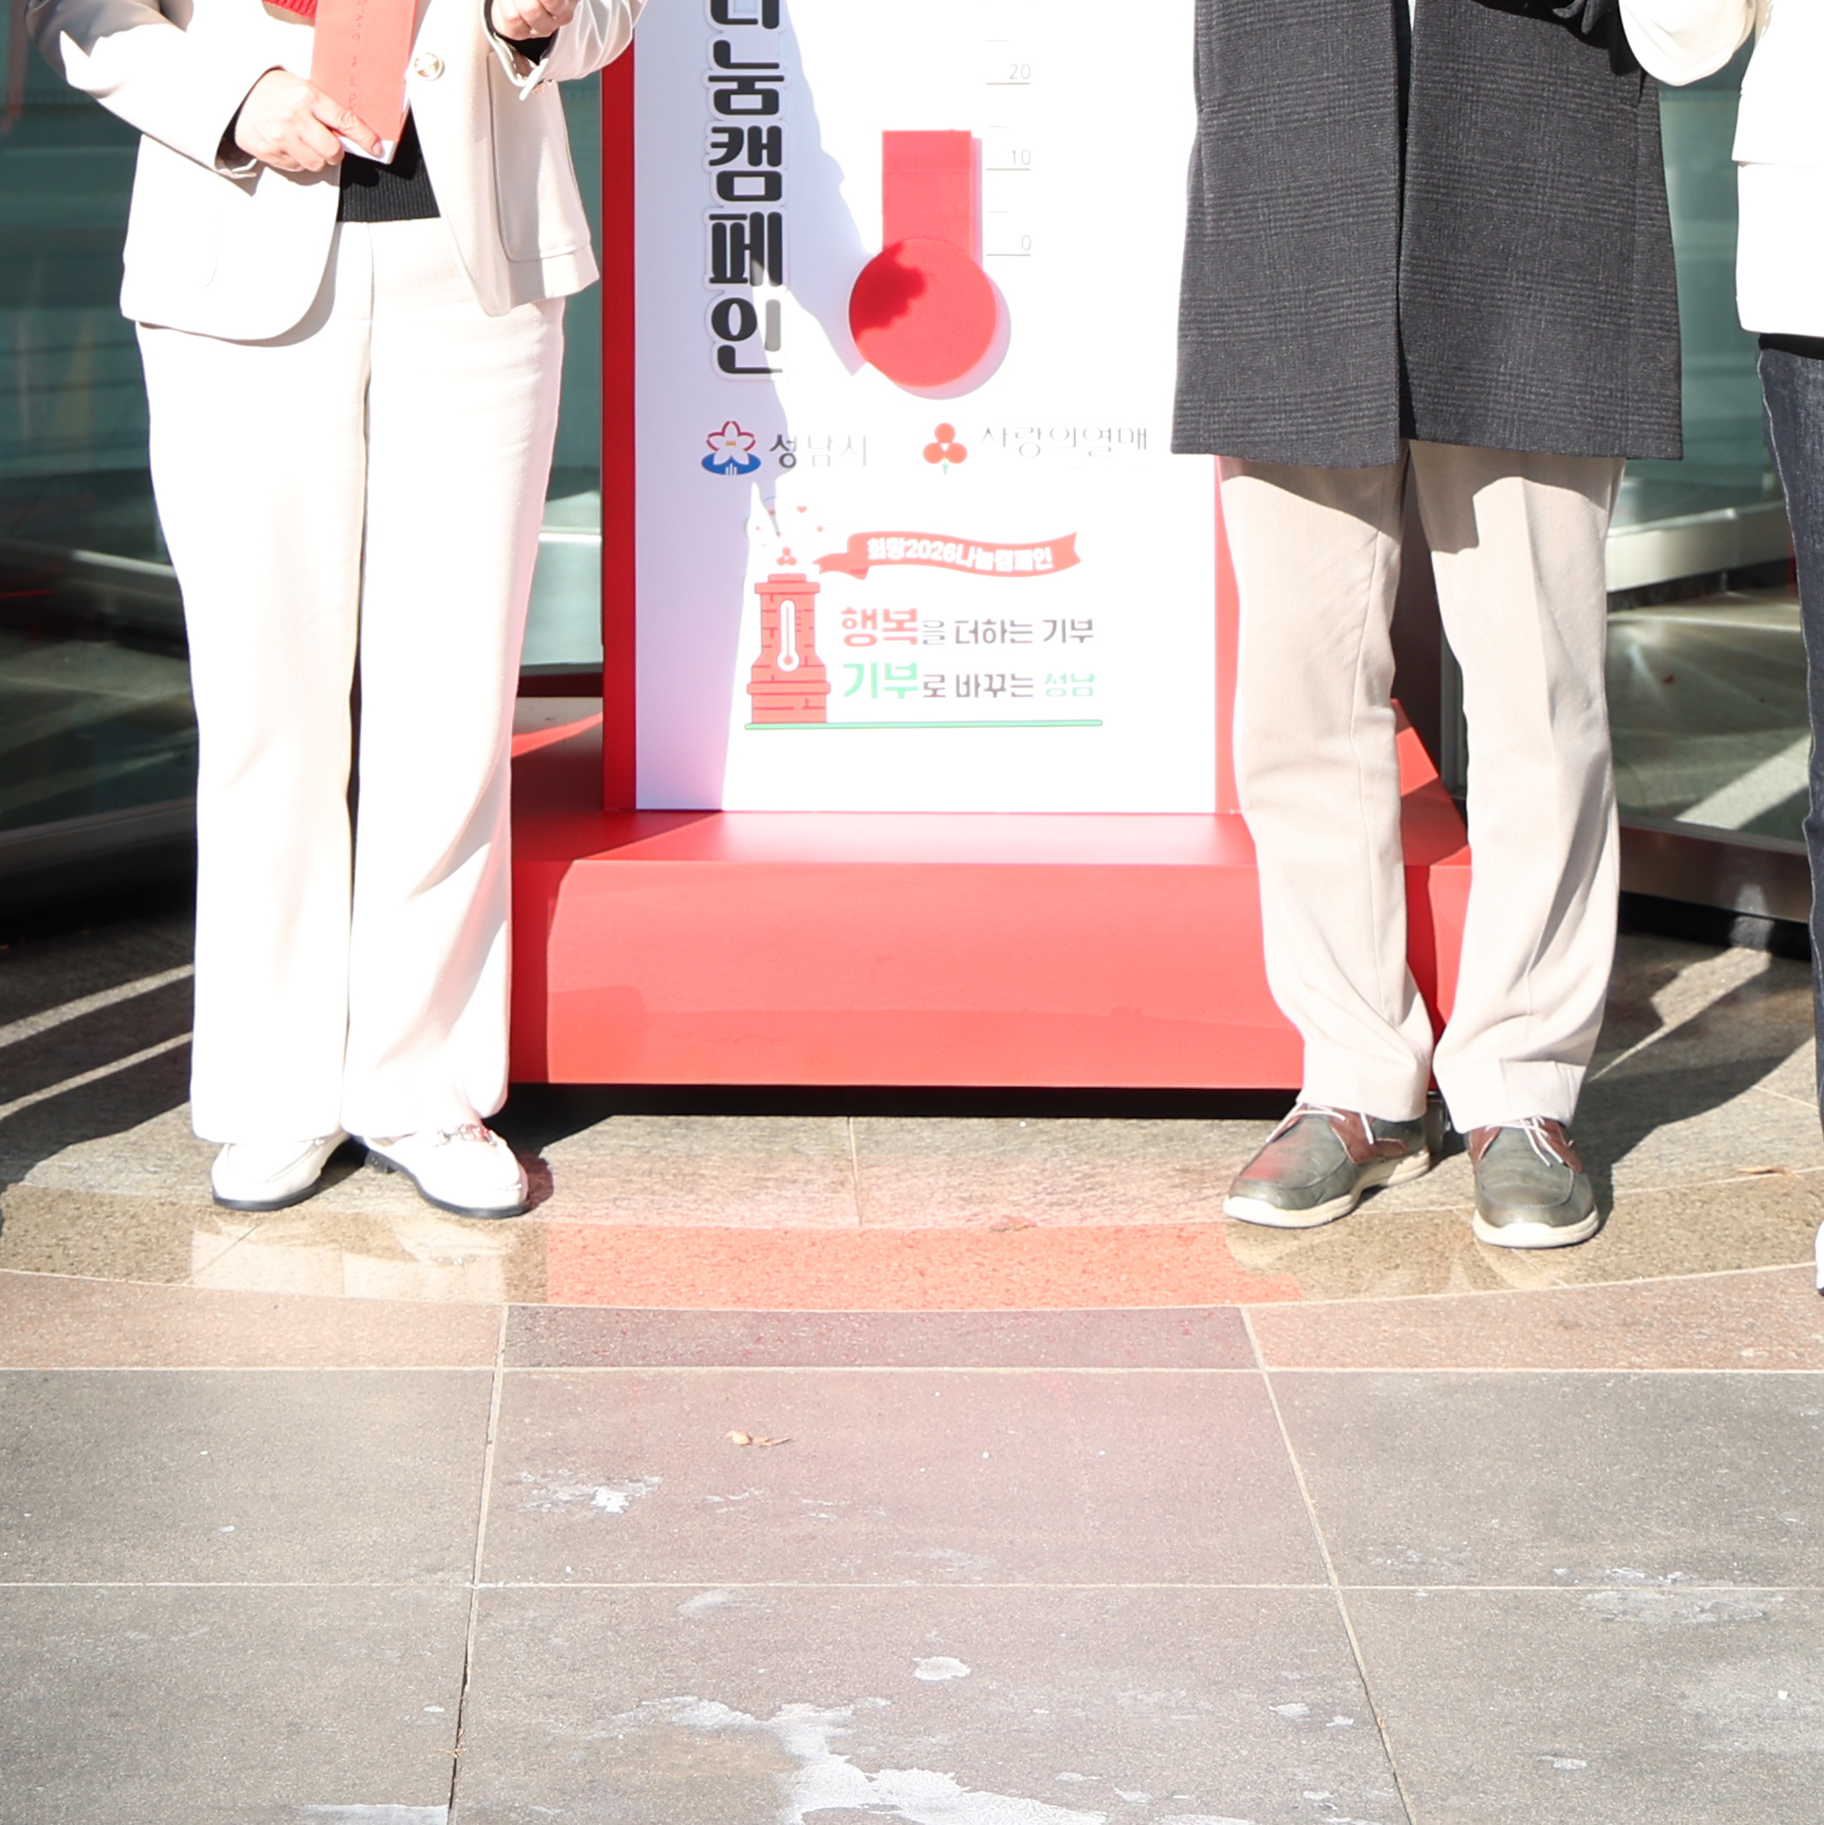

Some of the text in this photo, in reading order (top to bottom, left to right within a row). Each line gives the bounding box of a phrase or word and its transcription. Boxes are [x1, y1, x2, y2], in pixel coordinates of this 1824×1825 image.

[1010, 64, 1031, 80] 20
[1012, 149, 1031, 165] 10
[1021, 235, 1031, 251] 0
[768, 433, 868, 469] 성남시
[983, 427, 1147, 457] 사랑의열매
[867, 536, 1054, 572] 희망2026나눔캠페인
[841, 607, 1093, 647] 행복을 더하는 기부
[843, 662, 1095, 699] 기부로 바꾸는 성남
